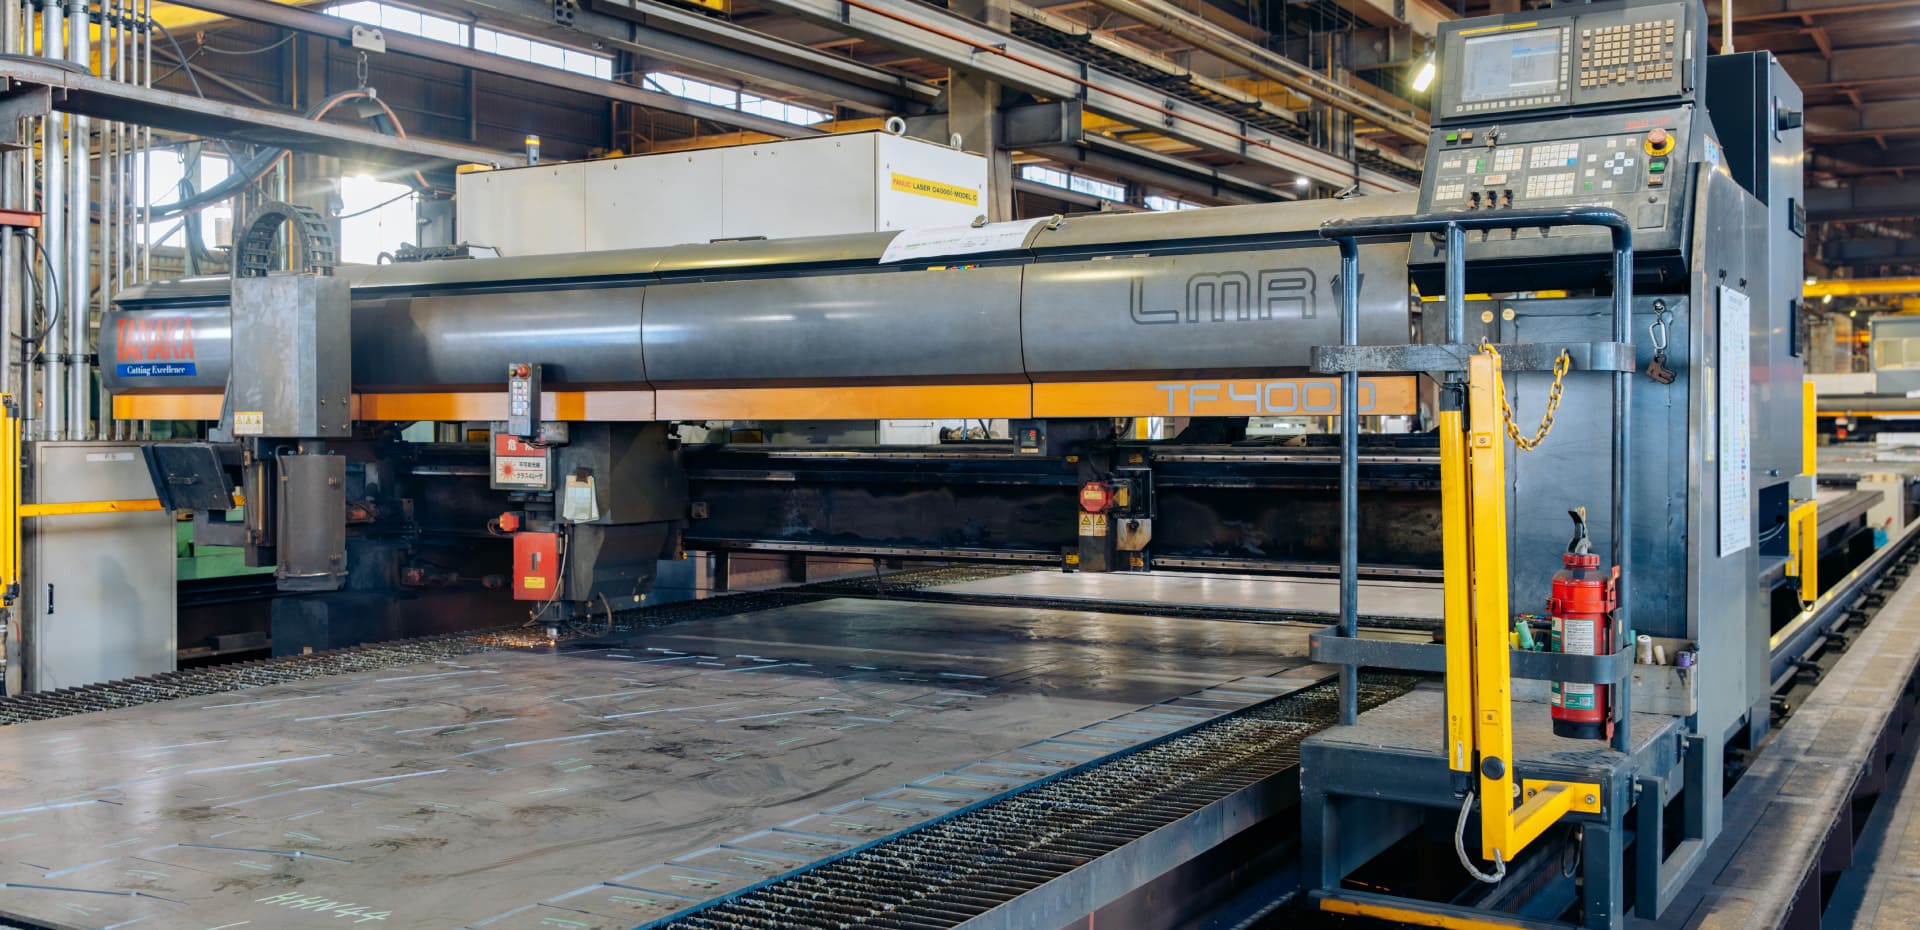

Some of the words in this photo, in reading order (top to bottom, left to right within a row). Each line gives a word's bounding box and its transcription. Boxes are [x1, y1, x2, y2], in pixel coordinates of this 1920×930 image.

[913, 183, 931, 192] LASER
[1130, 267, 1316, 325] LMR
[116, 316, 195, 361] TANAKA
[127, 365, 151, 376] Cutting
[152, 364, 186, 374] Excellence
